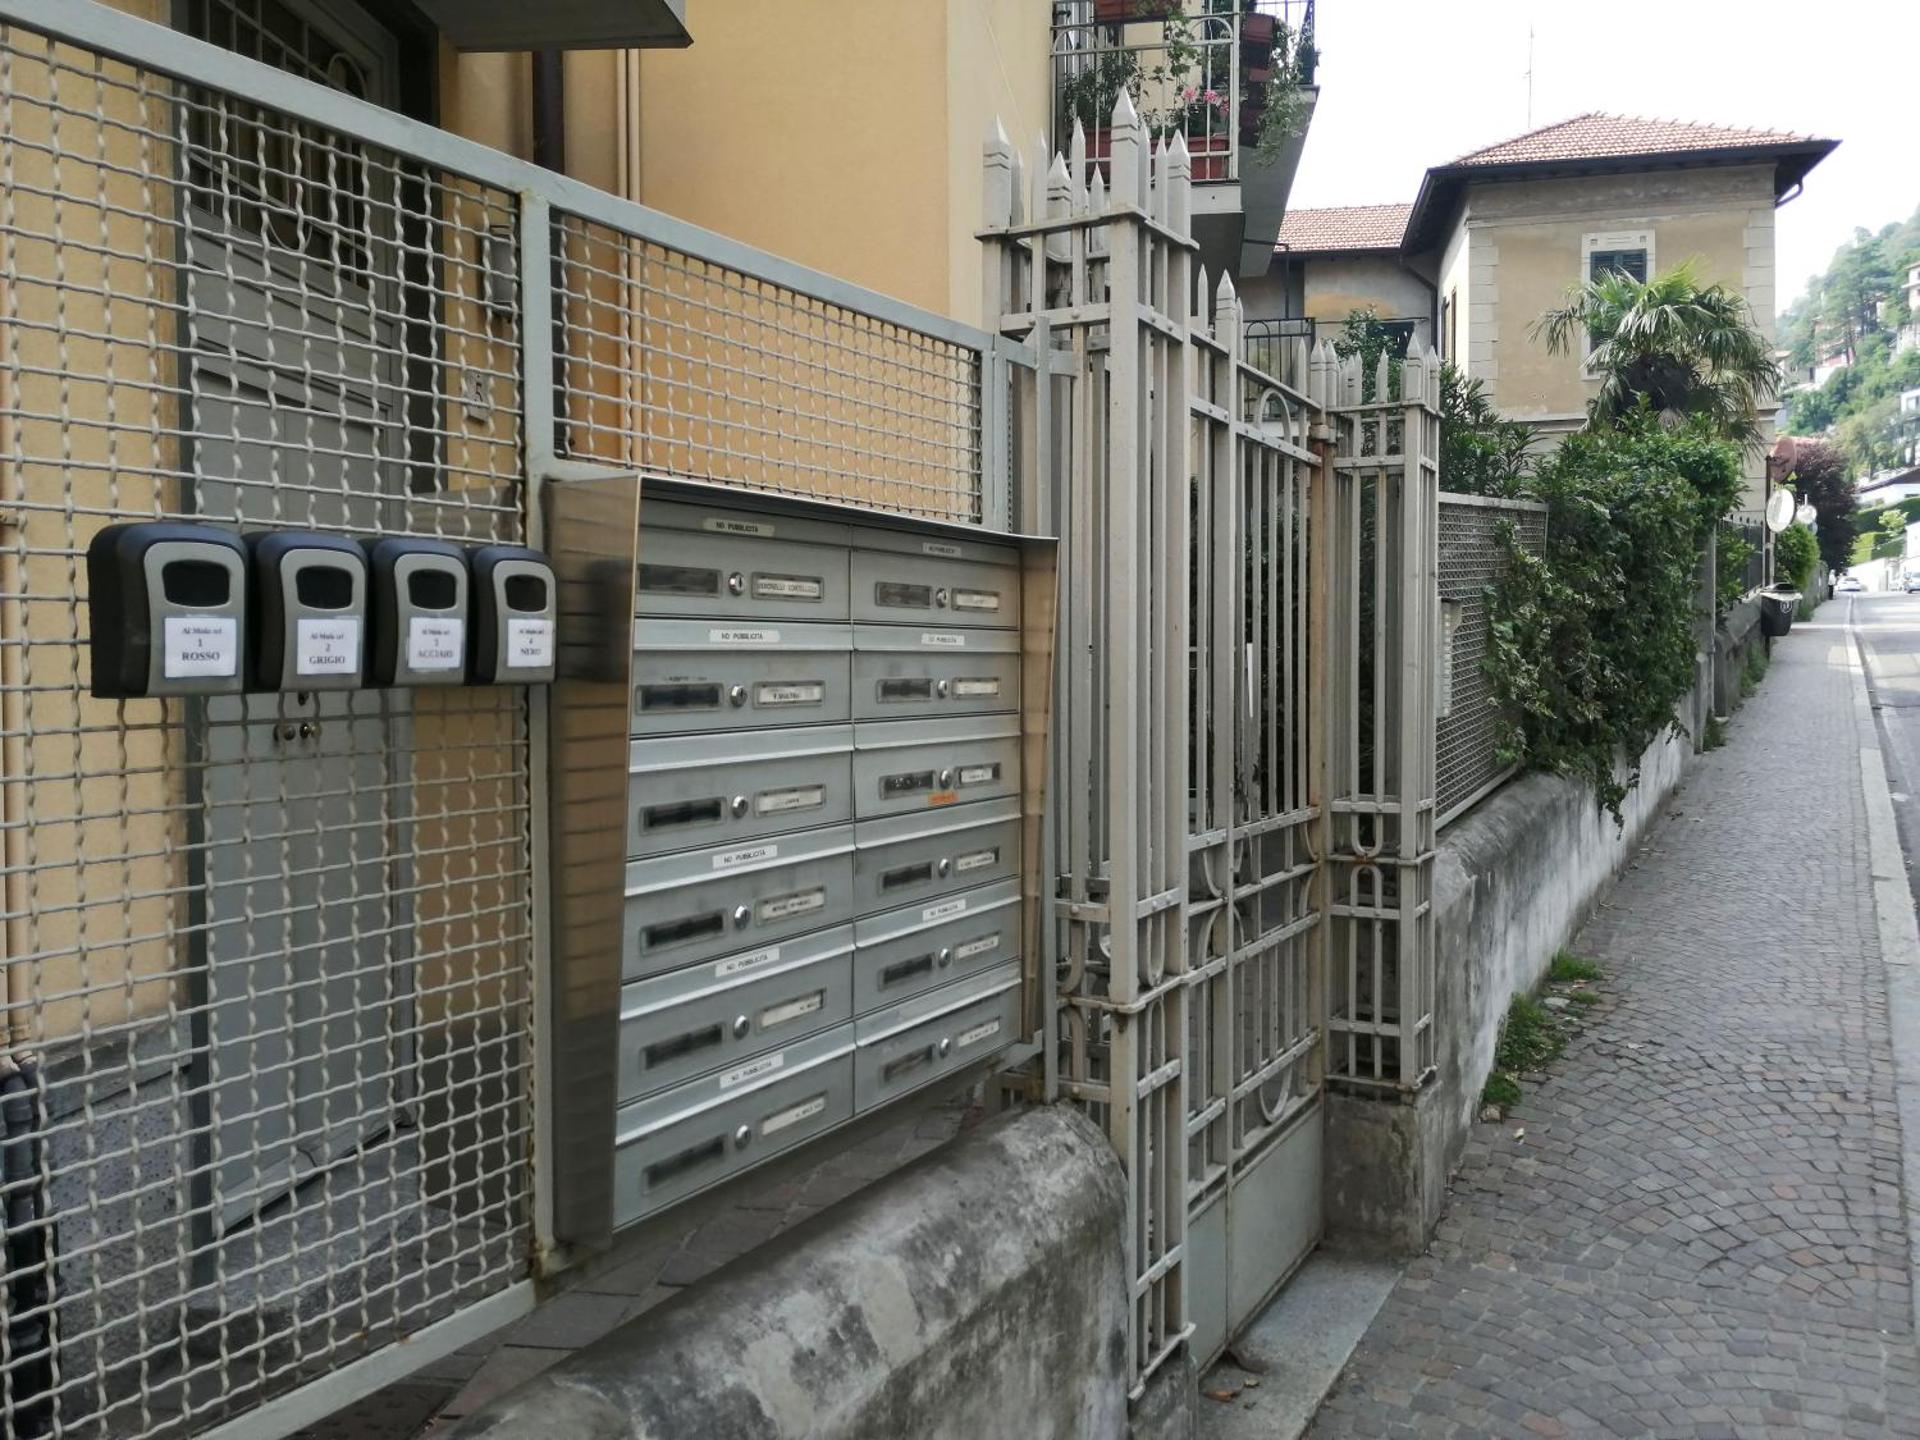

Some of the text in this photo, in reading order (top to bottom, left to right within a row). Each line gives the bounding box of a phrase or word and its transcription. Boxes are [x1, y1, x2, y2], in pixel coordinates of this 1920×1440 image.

[716, 521, 725, 530] NO
[721, 632, 730, 641] NO
[181, 651, 221, 661] ROSSO
[308, 655, 346, 665] GRIGIO
